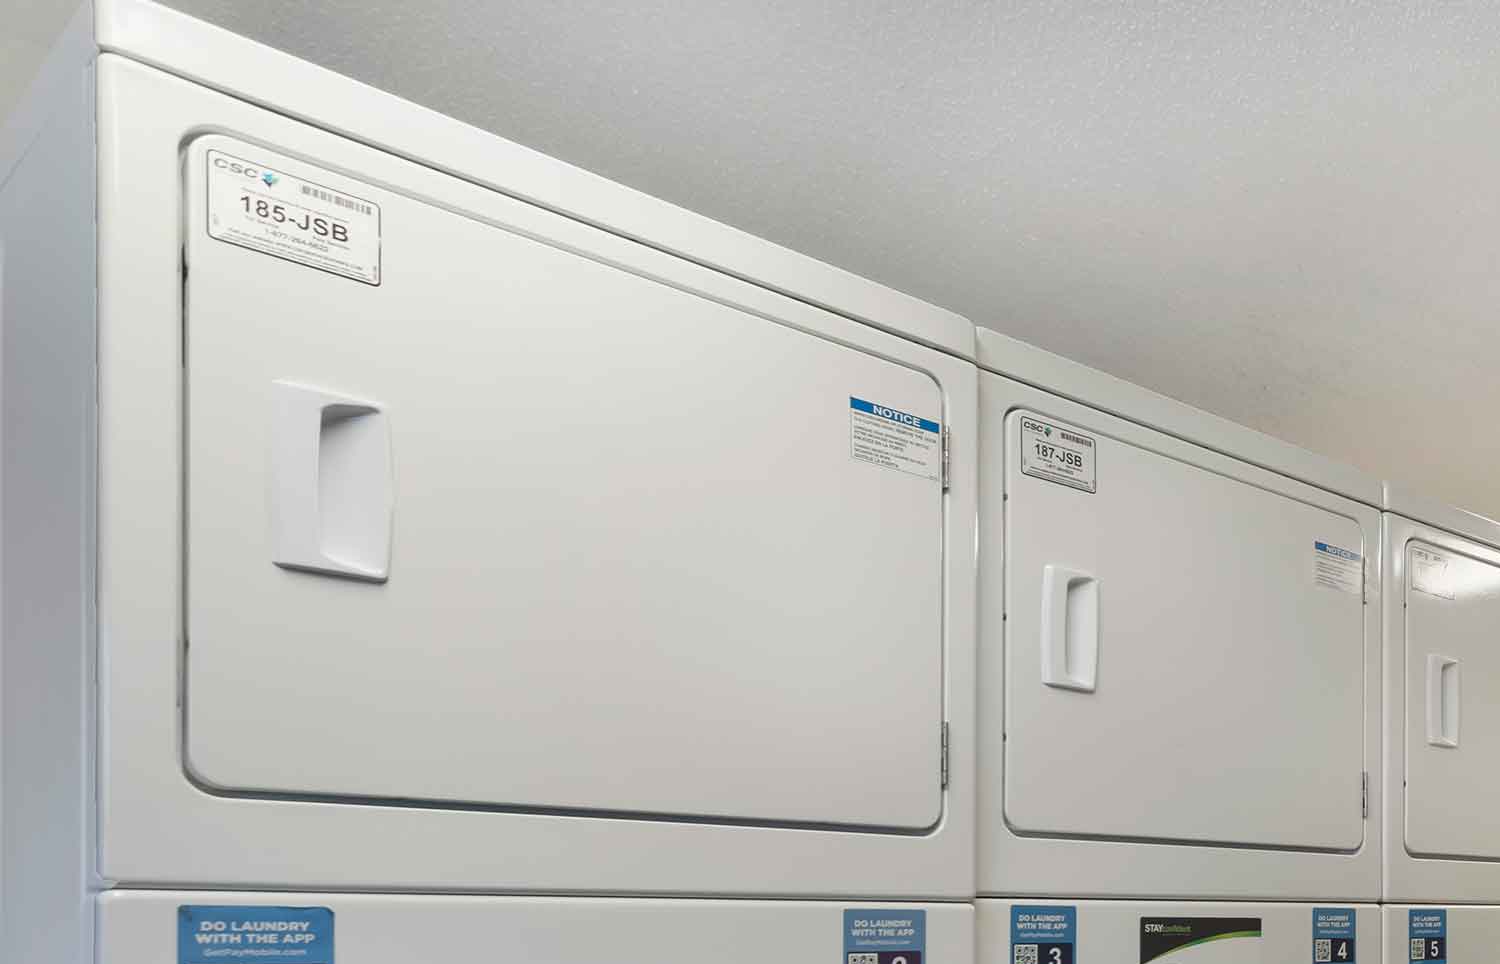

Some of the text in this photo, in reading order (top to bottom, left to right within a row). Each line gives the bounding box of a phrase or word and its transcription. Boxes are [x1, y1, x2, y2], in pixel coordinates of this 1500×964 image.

[214, 157, 258, 179] CSC
[241, 195, 350, 242] 185-JSB
[872, 405, 921, 428] NOTICE
[1023, 421, 1044, 433] CSC
[1035, 443, 1082, 467] 187-JSB
[200, 921, 310, 931] DO LAUNDRY
[195, 933, 315, 944] WITH THE APP
[1337, 941, 1348, 960] 4
[1430, 940, 1439, 957] 5
